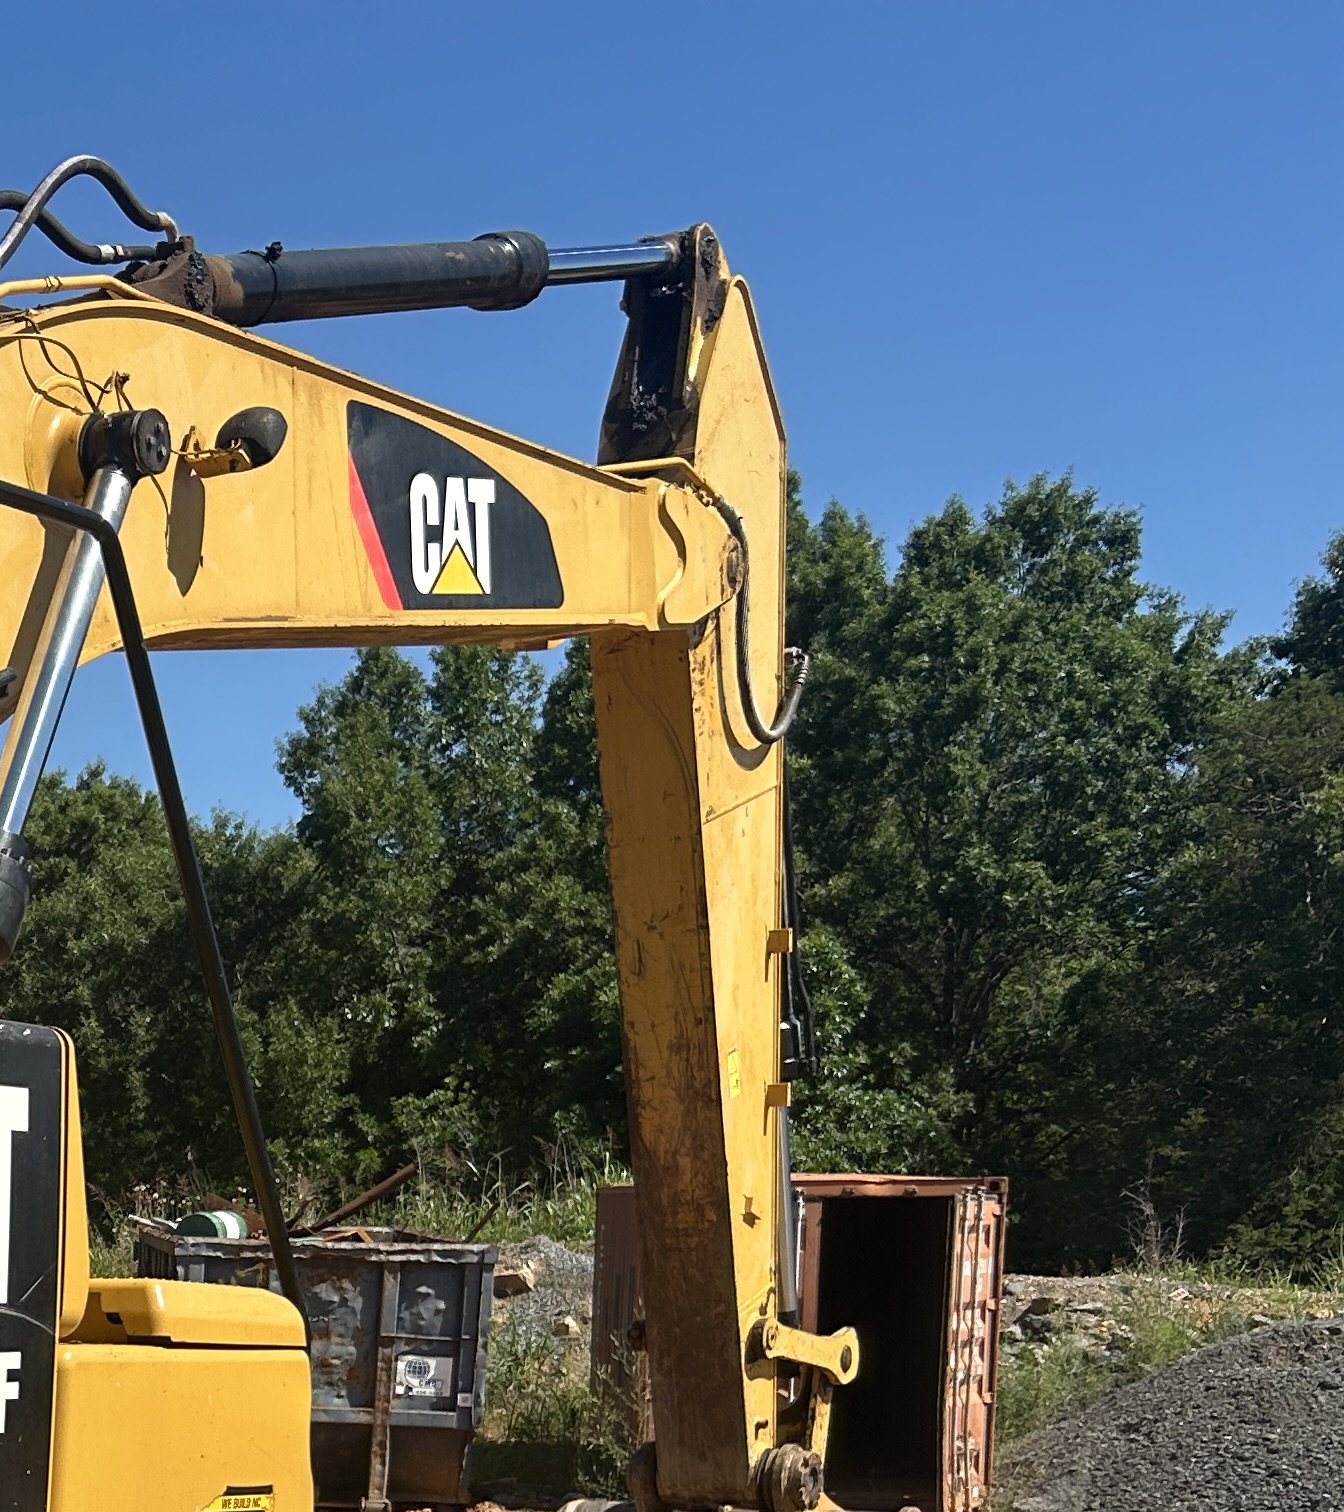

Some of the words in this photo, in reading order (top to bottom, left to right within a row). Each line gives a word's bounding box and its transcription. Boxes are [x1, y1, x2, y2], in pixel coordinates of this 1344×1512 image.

[410, 472, 495, 594] CAT
[221, 1498, 232, 1509] WE
[252, 1497, 262, 1508] NC
